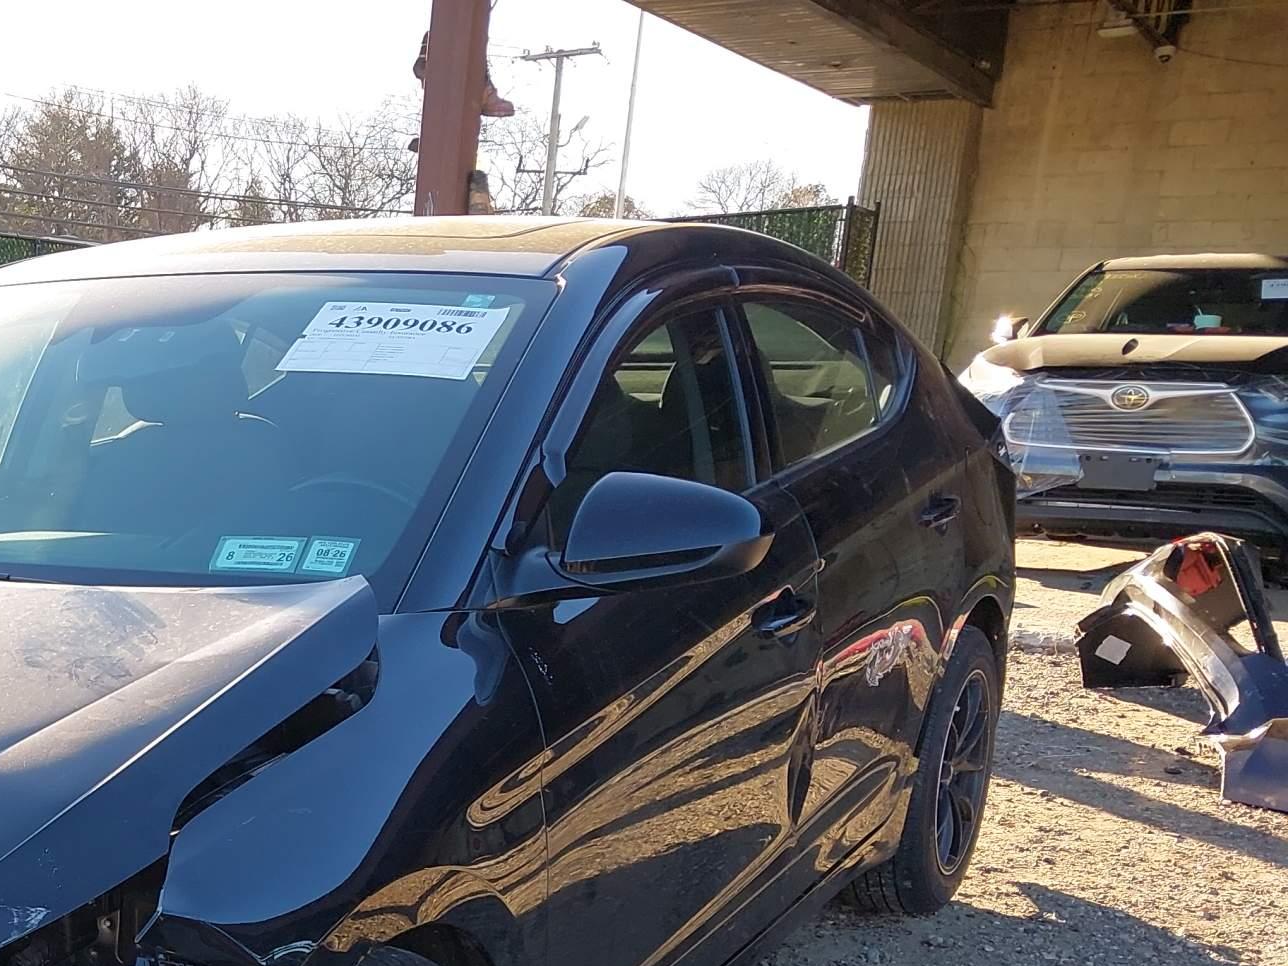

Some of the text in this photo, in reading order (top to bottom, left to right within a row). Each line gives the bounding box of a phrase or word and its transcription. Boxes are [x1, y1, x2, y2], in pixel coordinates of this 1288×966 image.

[328, 314, 479, 335] 43909086
[225, 550, 235, 561] 8
[276, 552, 294, 562] 26
